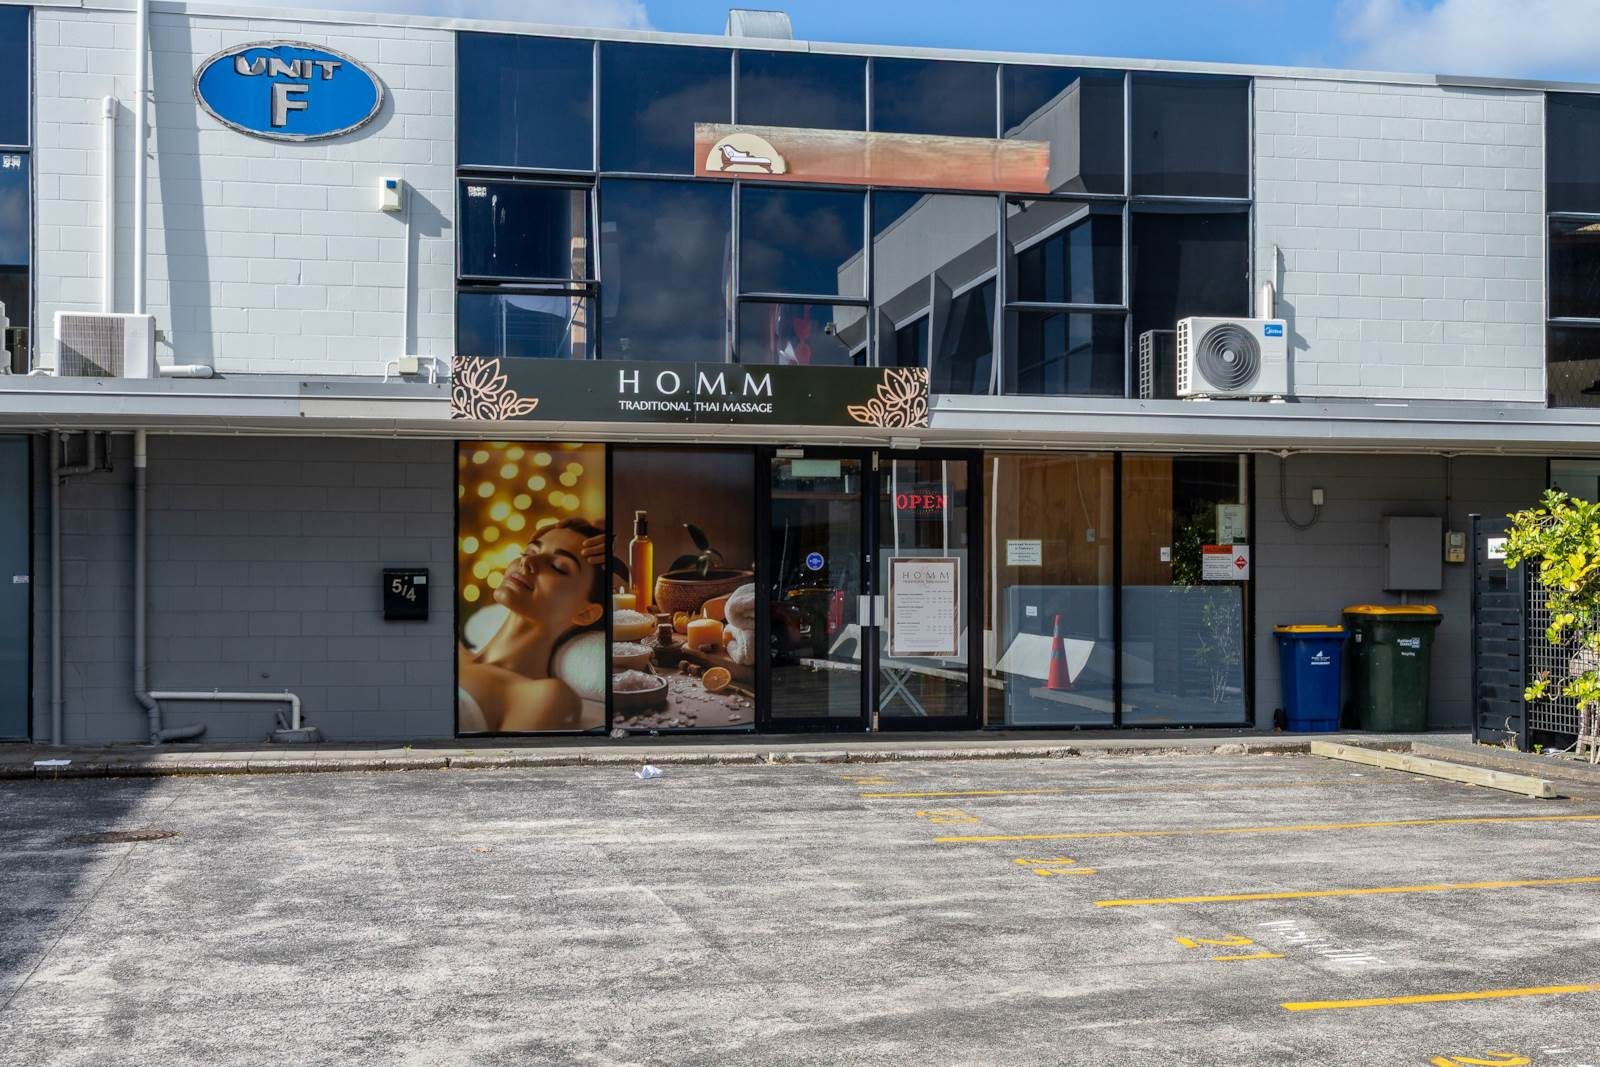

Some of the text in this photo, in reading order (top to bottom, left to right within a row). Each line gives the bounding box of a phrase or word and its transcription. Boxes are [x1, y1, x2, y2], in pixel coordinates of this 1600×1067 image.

[234, 54, 342, 80] UNIT
[271, 82, 309, 126] F
[618, 400, 773, 414] TRADITIONAL THAI MASSAGE
[896, 494, 949, 510] OPEN
[391, 578, 417, 602] 5/4
